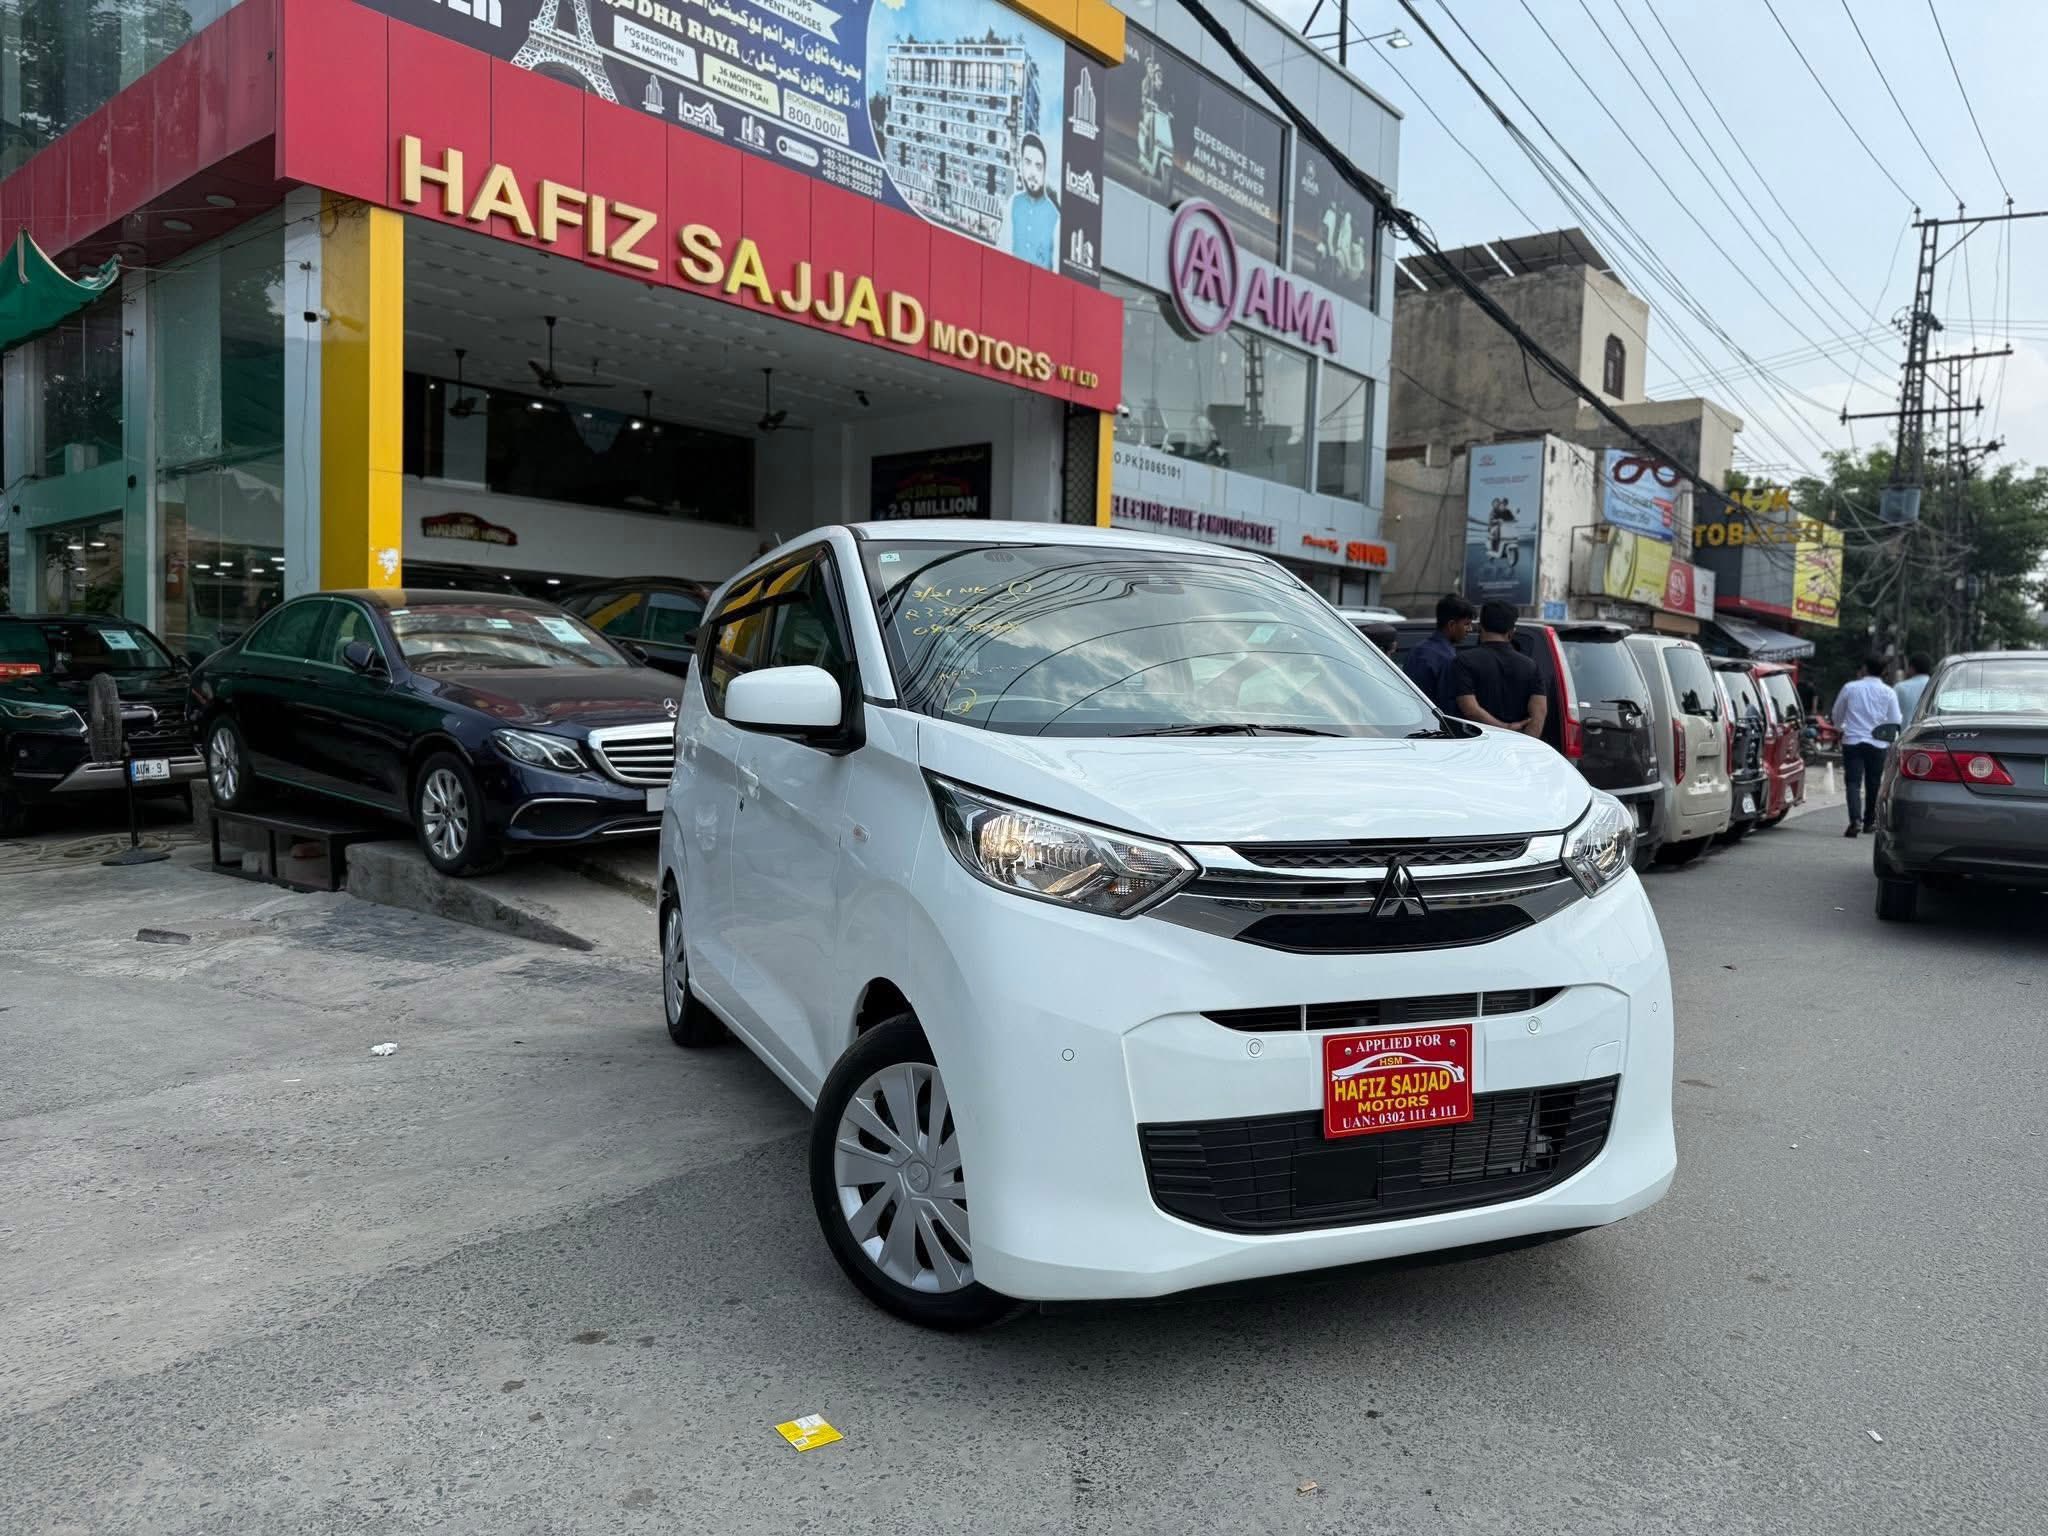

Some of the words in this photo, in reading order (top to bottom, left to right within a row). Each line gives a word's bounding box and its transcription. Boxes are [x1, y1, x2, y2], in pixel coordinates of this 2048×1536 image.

[637, 0, 683, 33] DHA
[687, 18, 740, 59] RAYA
[788, 7, 821, 32] HOUSES
[624, 25, 675, 53] POSSESSION
[675, 47, 685, 58] IN
[631, 39, 641, 51] 36
[641, 44, 679, 67] MONTHS
[711, 74, 749, 99] PAYMENT
[749, 89, 769, 106] PLAN
[728, 70, 763, 92] MONTHS
[1193, 126, 1248, 169] EXPERIENCE
[1248, 159, 1266, 180] THE
[1184, 160, 1206, 183] AND
[1206, 172, 1271, 219] PERFORMANCE
[1232, 169, 1265, 198] POWER
[400, 134, 660, 273] HAFIZ
[677, 222, 926, 346] SAJJAD
[931, 319, 1051, 382] MOTORS
[1077, 369, 1099, 389] LTD
[1243, 267, 1338, 354] AIMA
[913, 495, 978, 516] MILLION
[1356, 1036, 1412, 1053] APPLIED
[1415, 1033, 1441, 1046] FOR
[1379, 1056, 1403, 1066] HSM
[1334, 1076, 1386, 1102] HAFIZ
[1391, 1070, 1450, 1096] SAJJAD
[1342, 1115, 1375, 1129] UAN:
[1379, 1111, 1405, 1125] 0302
[1409, 1108, 1425, 1121] 111
[1429, 1107, 1436, 1118] 4
[1440, 1105, 1457, 1116] 111
[1357, 1095, 1429, 1114] MOTORS
